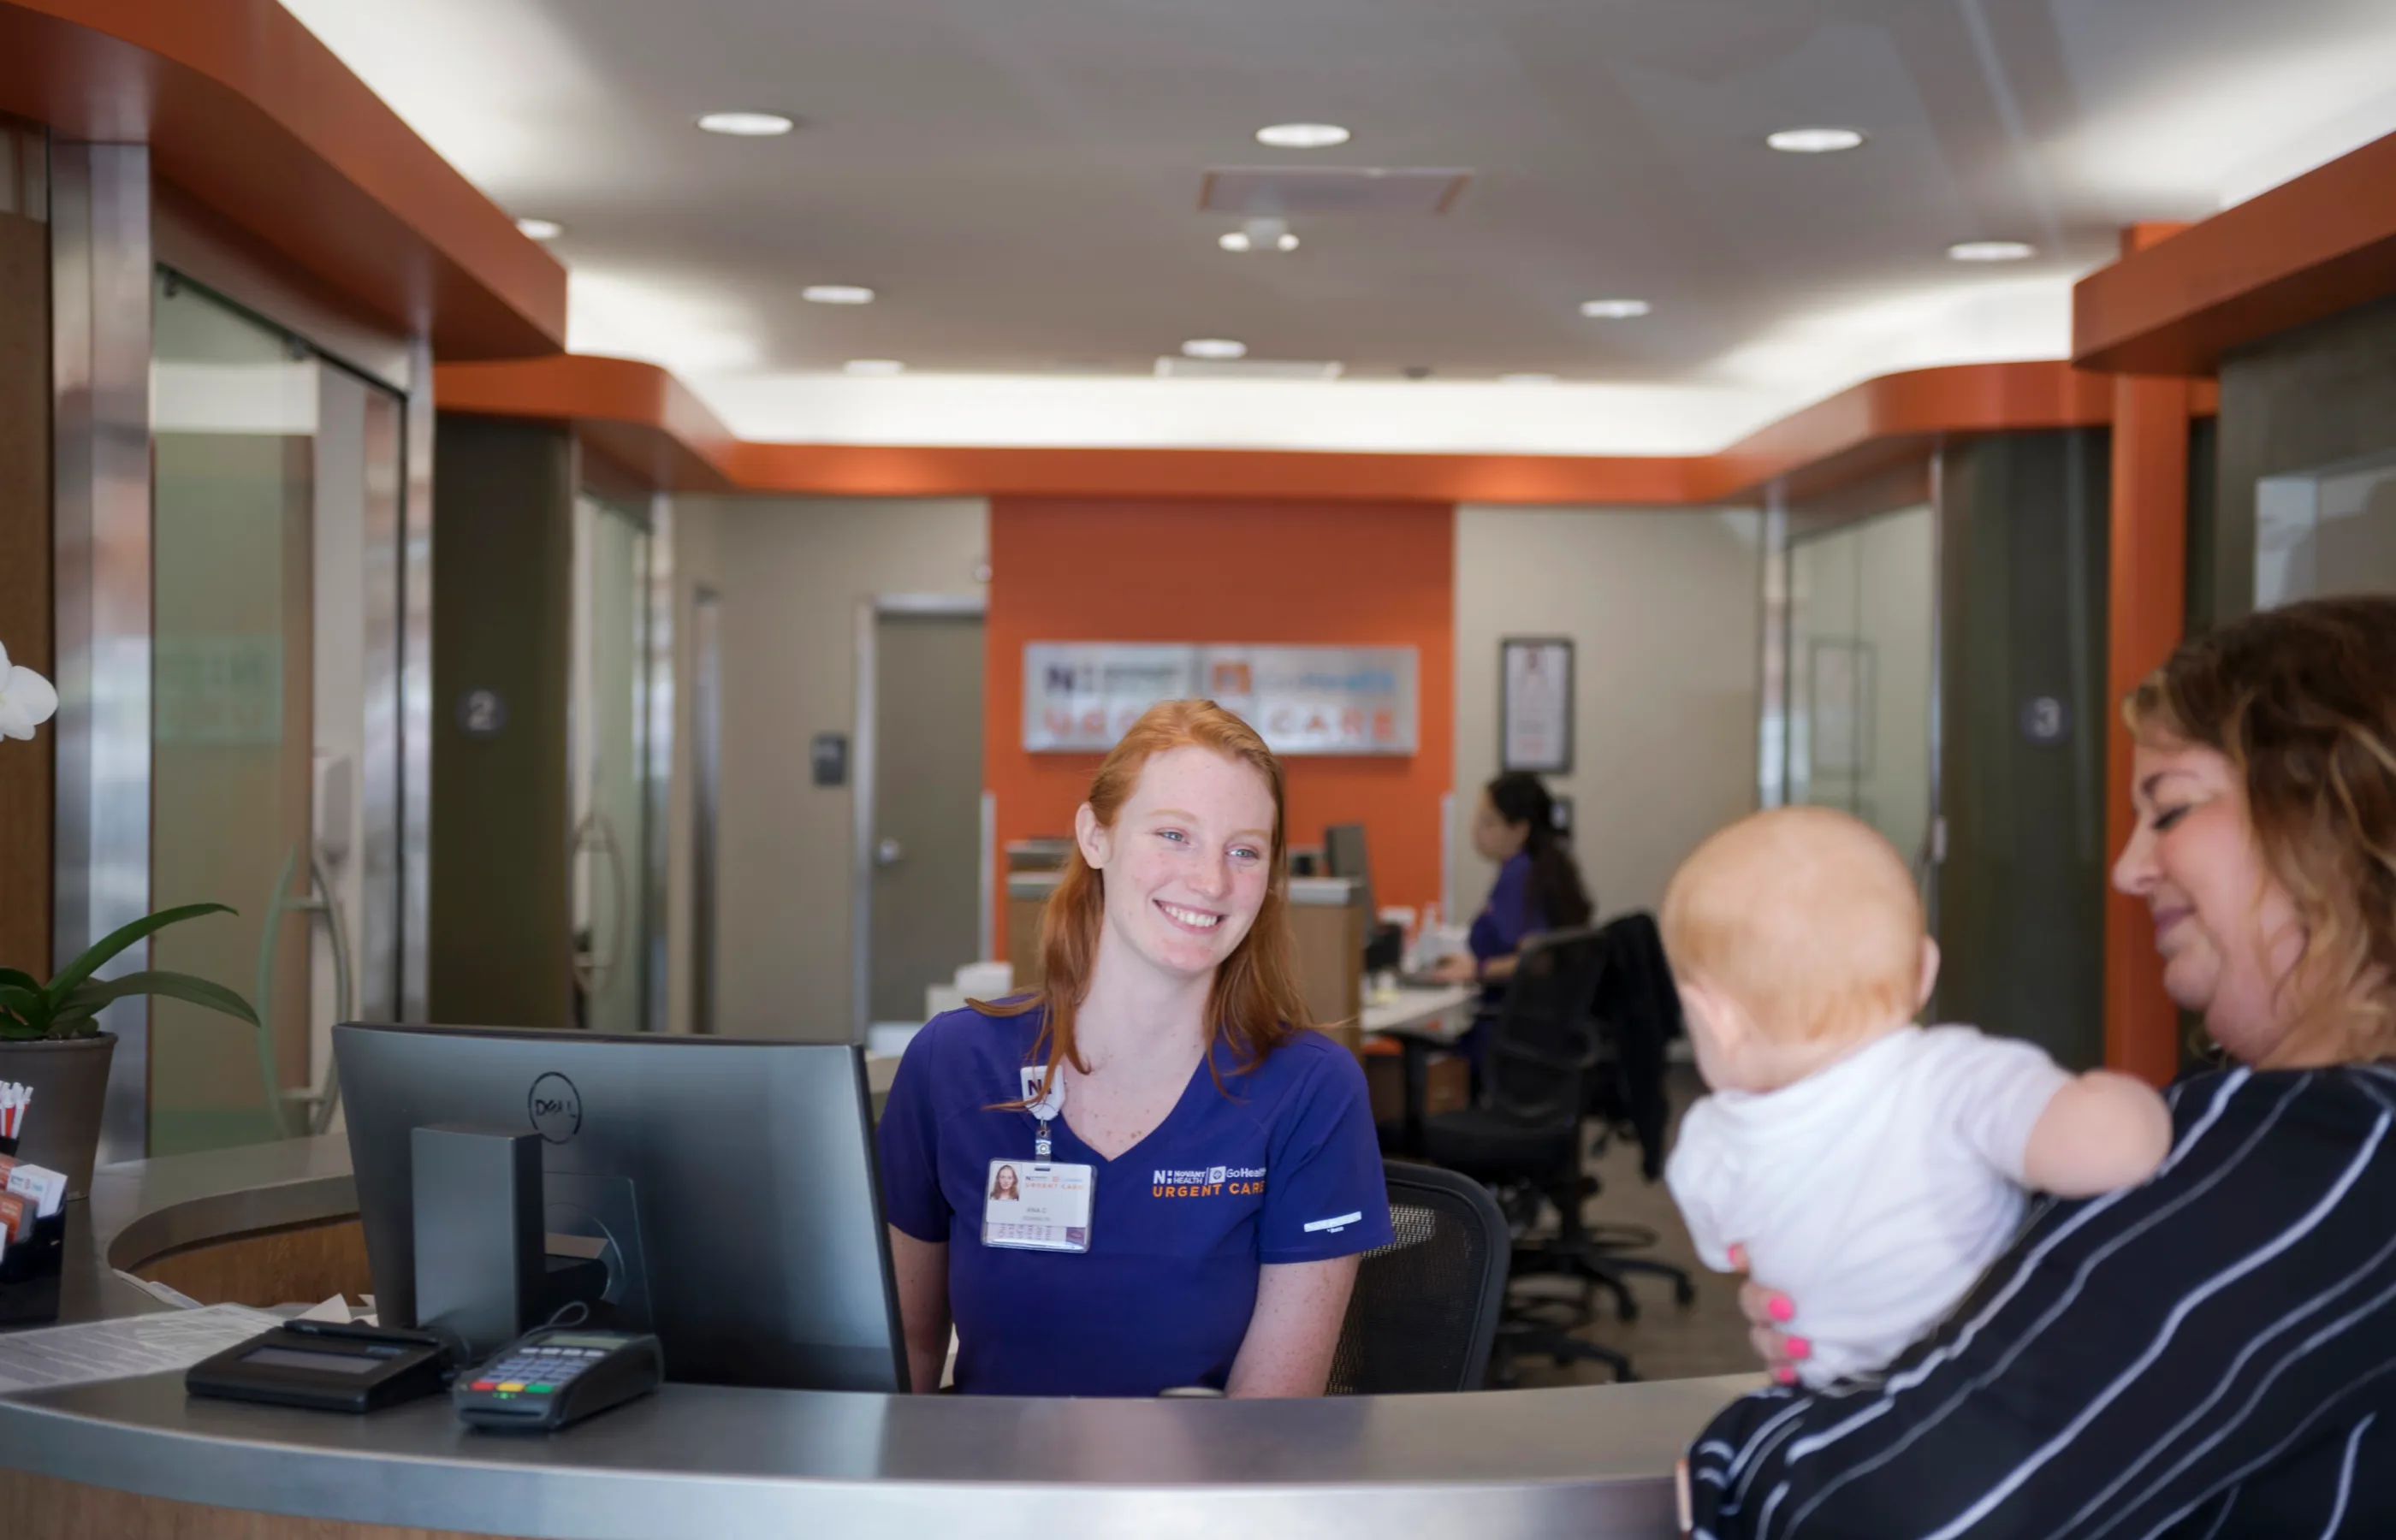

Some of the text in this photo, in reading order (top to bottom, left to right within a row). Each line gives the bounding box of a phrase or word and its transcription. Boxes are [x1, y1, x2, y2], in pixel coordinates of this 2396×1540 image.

[468, 690, 495, 730] 2
[2033, 696, 2061, 737] 3
[1173, 1170, 1207, 1178] NOVANT
[1173, 1176, 1203, 1185] HEALTH
[1152, 1183, 1223, 1198] URGENT
